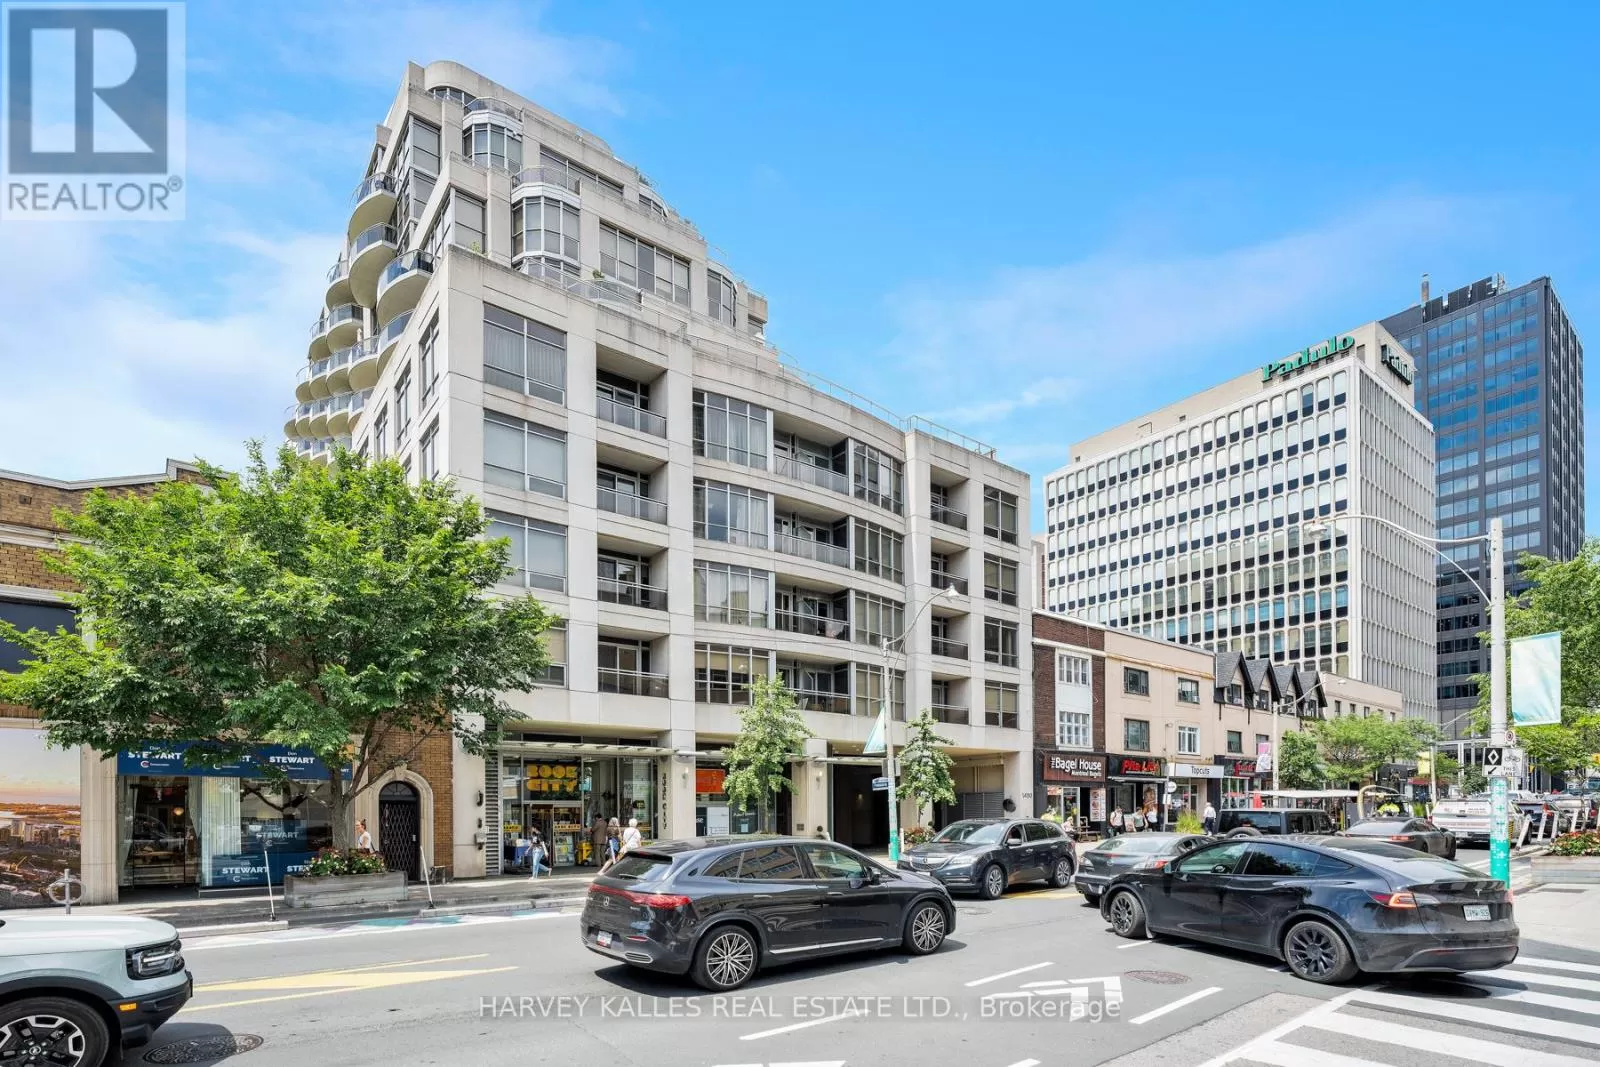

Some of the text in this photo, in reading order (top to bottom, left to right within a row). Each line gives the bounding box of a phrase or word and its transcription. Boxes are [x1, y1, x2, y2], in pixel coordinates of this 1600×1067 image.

[1261, 336, 1355, 382] Padulo
[269, 756, 315, 764] STEWART
[1055, 757, 1078, 772] Bagel
[1079, 759, 1102, 771] House
[527, 764, 577, 779] BOOK
[527, 778, 577, 793] CITY
[222, 866, 268, 874] STEWART
